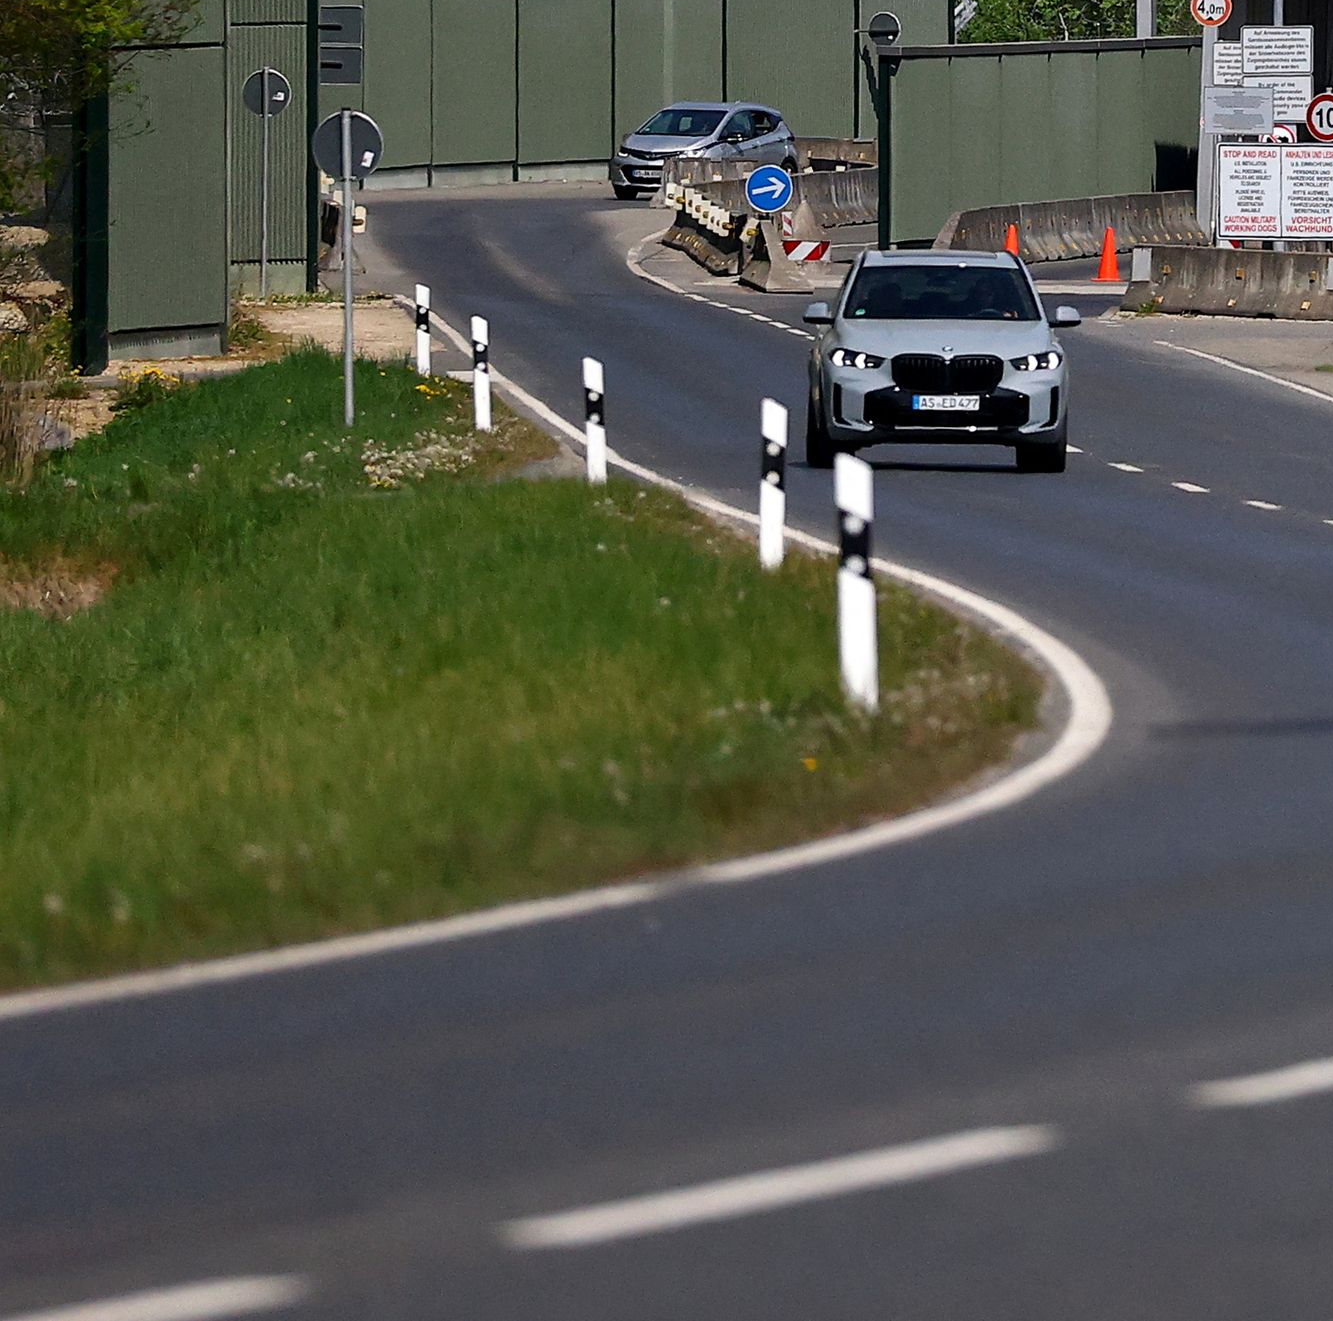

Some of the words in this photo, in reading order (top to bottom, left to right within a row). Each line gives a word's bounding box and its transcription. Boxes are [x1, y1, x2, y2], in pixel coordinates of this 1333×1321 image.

[1197, 0, 1224, 16] 4,0m
[1223, 150, 1242, 158] STOP
[1242, 150, 1257, 158] AND
[1257, 150, 1278, 159] READ
[1291, 216, 1333, 225] VORSICHT
[1257, 224, 1278, 233] DOGS
[920, 397, 935, 409] AS
